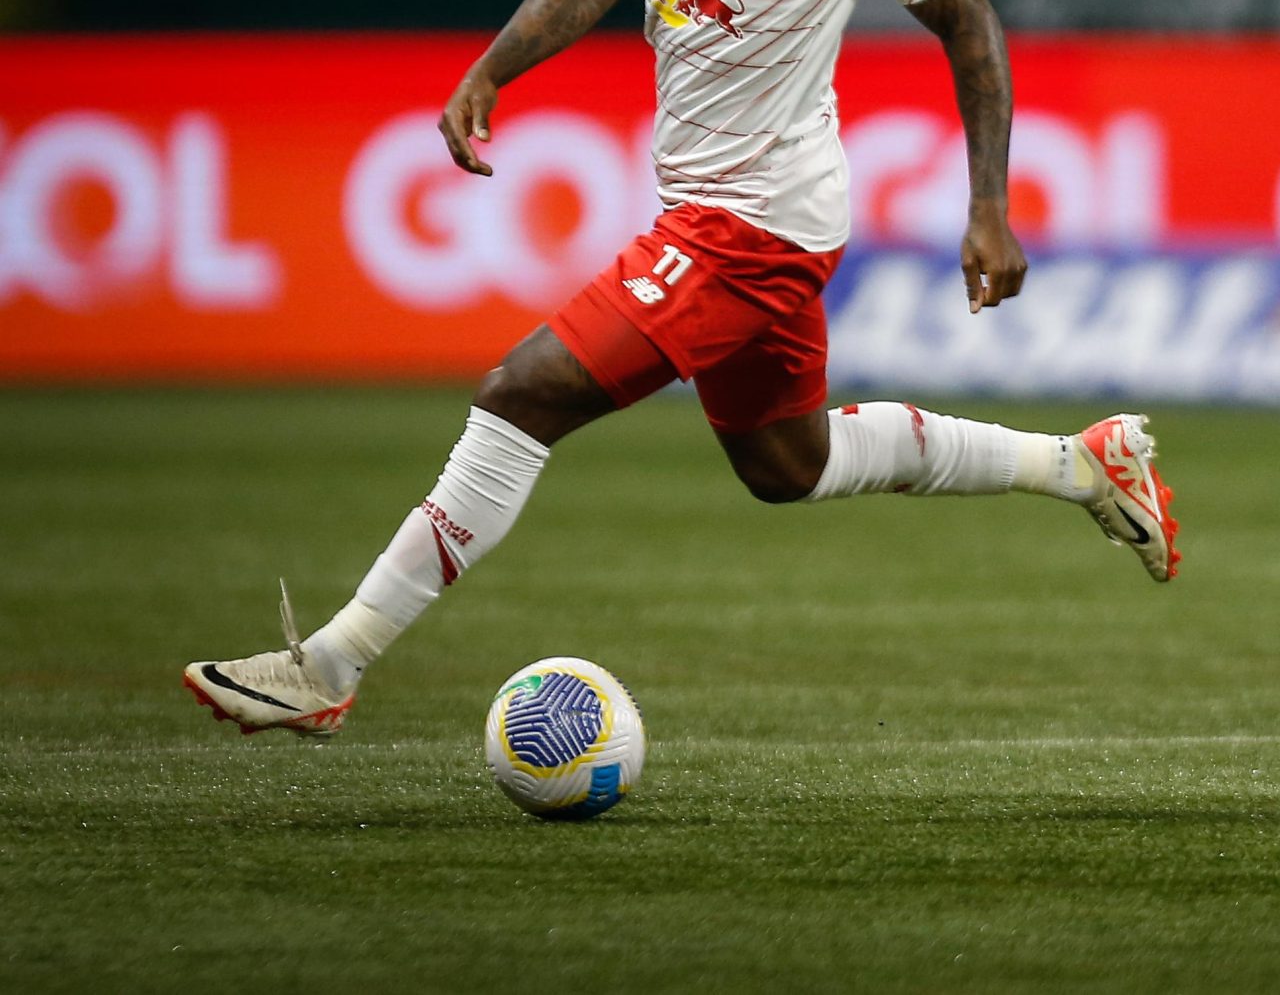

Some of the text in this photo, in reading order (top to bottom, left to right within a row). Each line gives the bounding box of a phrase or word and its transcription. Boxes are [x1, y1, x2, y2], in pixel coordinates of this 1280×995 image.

[0, 106, 286, 314] OL
[341, 107, 655, 314] GO
[652, 244, 693, 286] 11
